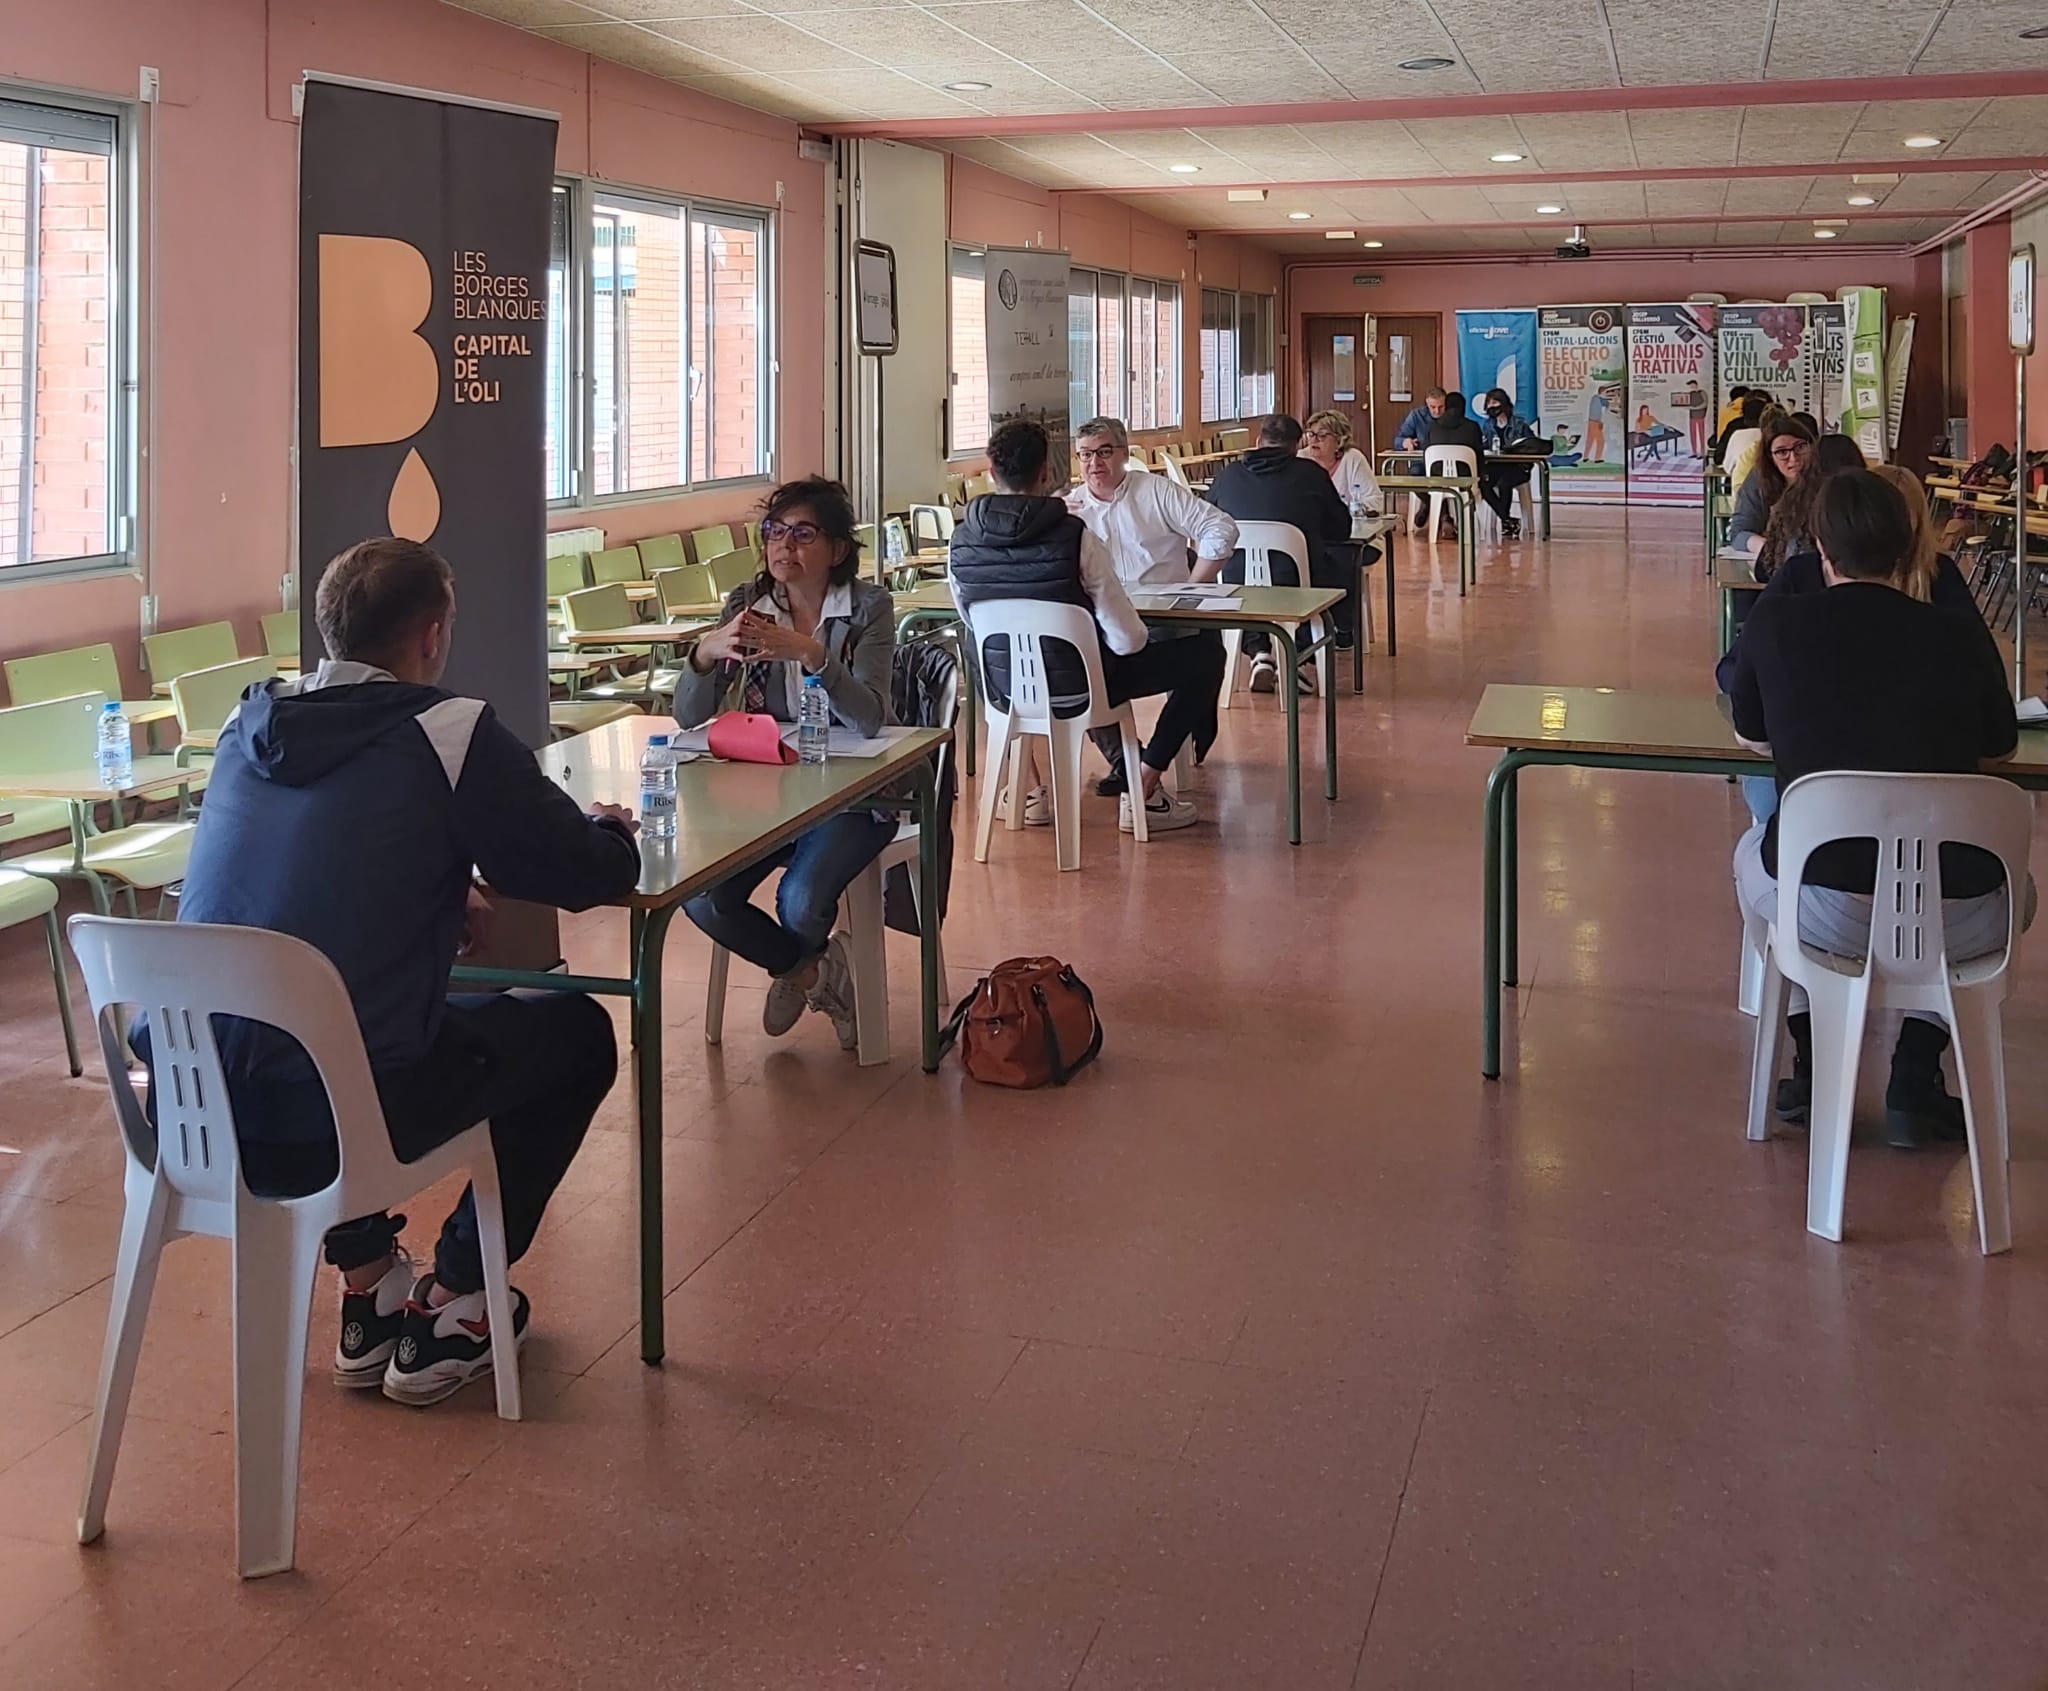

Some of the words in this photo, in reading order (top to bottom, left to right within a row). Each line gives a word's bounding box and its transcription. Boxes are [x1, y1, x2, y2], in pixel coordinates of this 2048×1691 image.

[454, 251, 487, 273] LES
[454, 275, 529, 298] BORGES
[1632, 331, 1665, 344] GESTIÓ
[1723, 336, 1754, 351] VITI
[454, 335, 532, 356] CAPITAL
[1543, 346, 1610, 360] ELECTRO
[1632, 344, 1704, 359] ADMINIS
[1632, 359, 1698, 374] TRATIVA
[1723, 351, 1758, 367] VINI
[1813, 358, 1845, 374] VNS
[454, 358, 479, 380] DE
[1723, 367, 1796, 382] CULTURA
[1544, 376, 1586, 390] QUES
[454, 381, 501, 404] L'OLI
